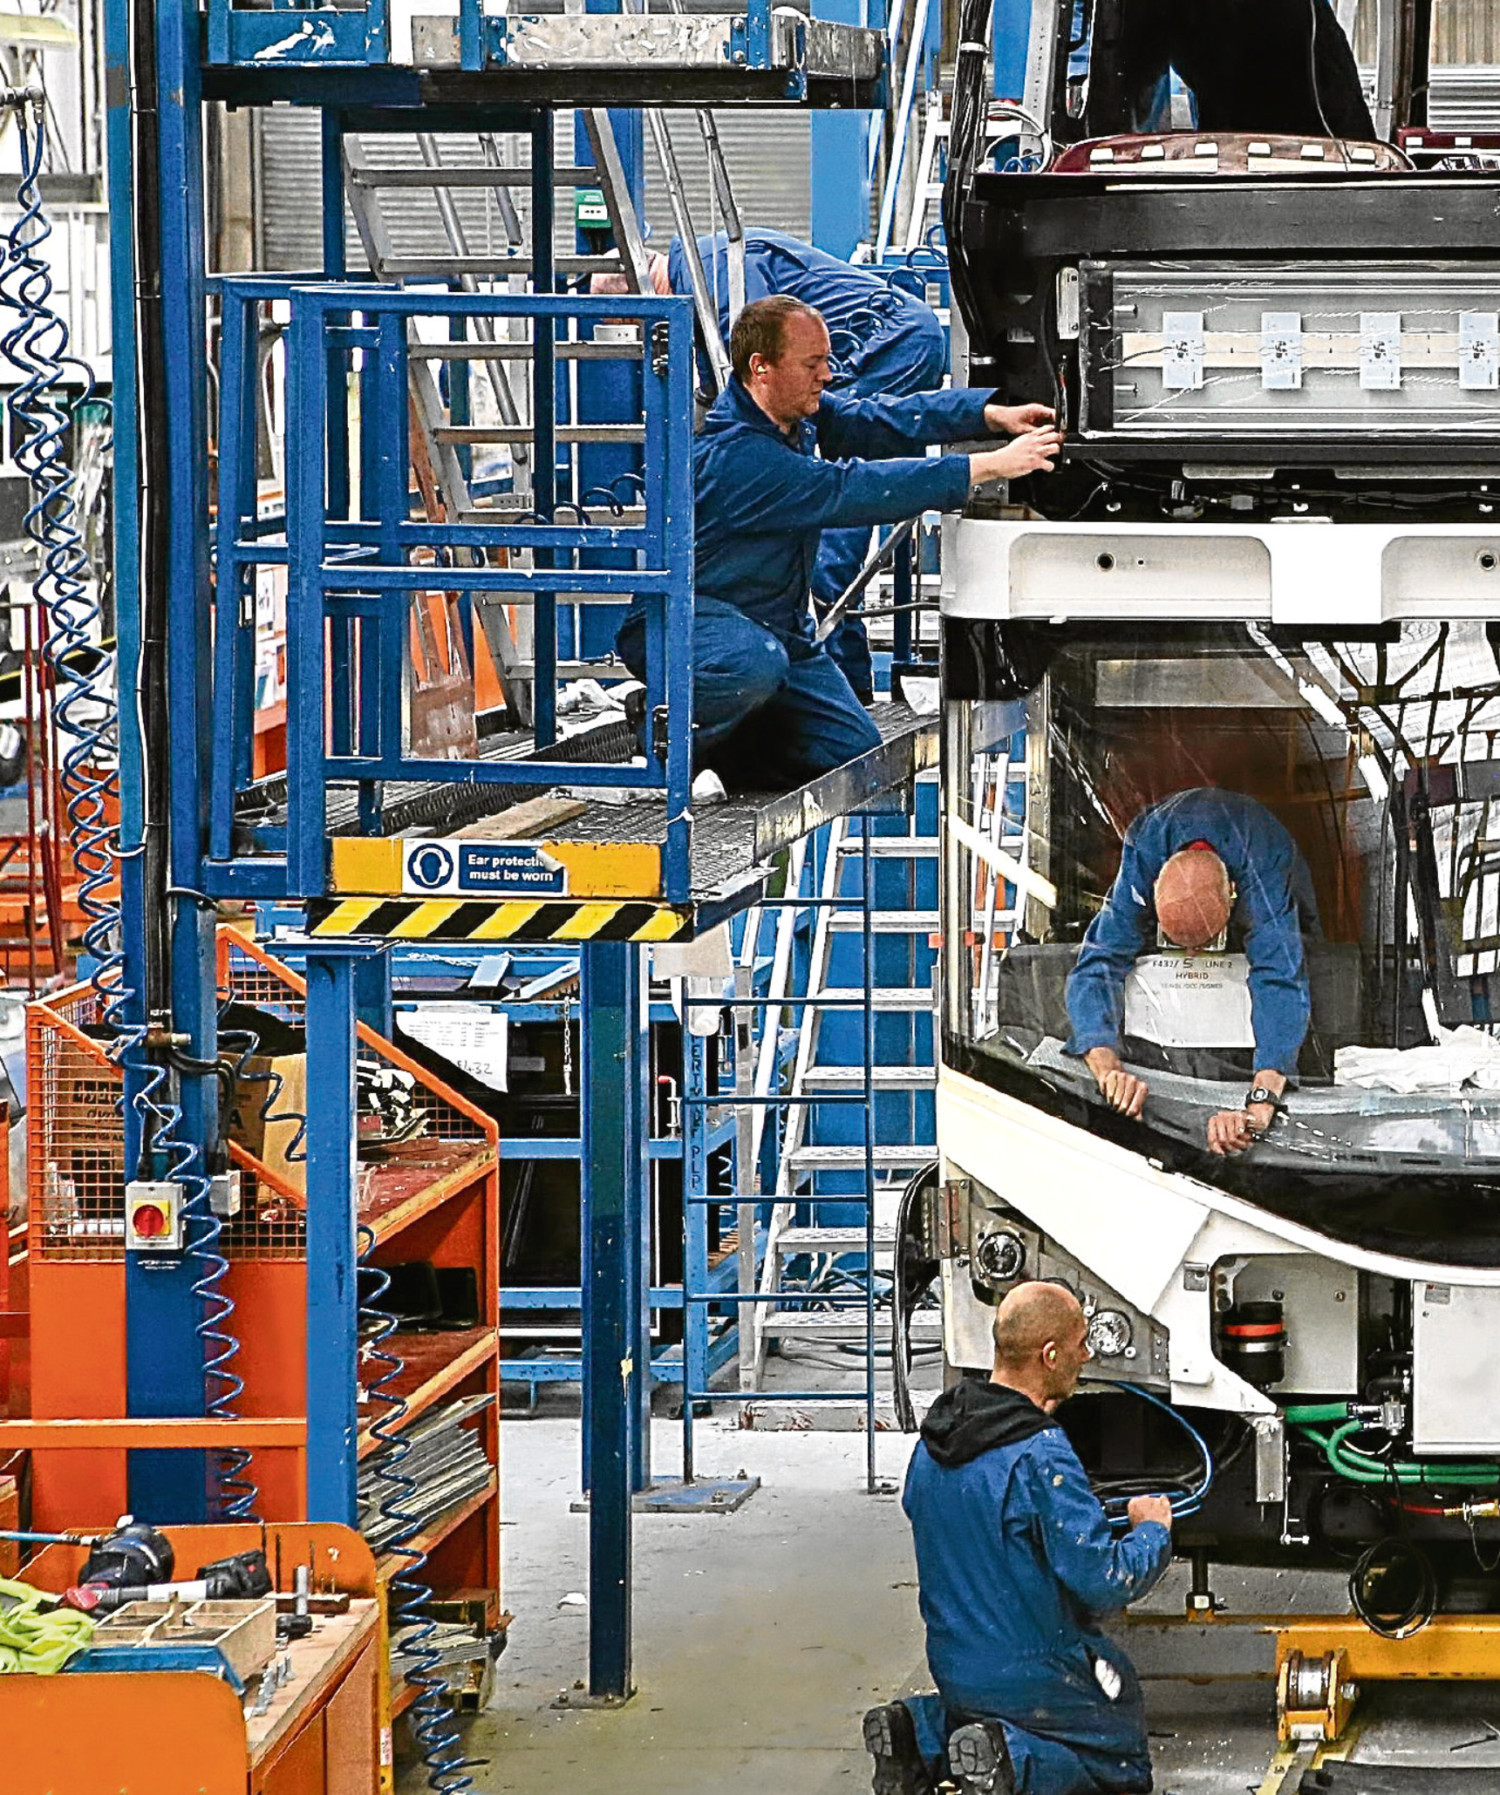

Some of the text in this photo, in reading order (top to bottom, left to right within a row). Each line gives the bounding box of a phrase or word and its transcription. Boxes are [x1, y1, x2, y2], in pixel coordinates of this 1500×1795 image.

[468, 854, 545, 868] Ear protecti
[469, 869, 554, 882] must be worn
[1175, 972, 1209, 980] HYBRID
